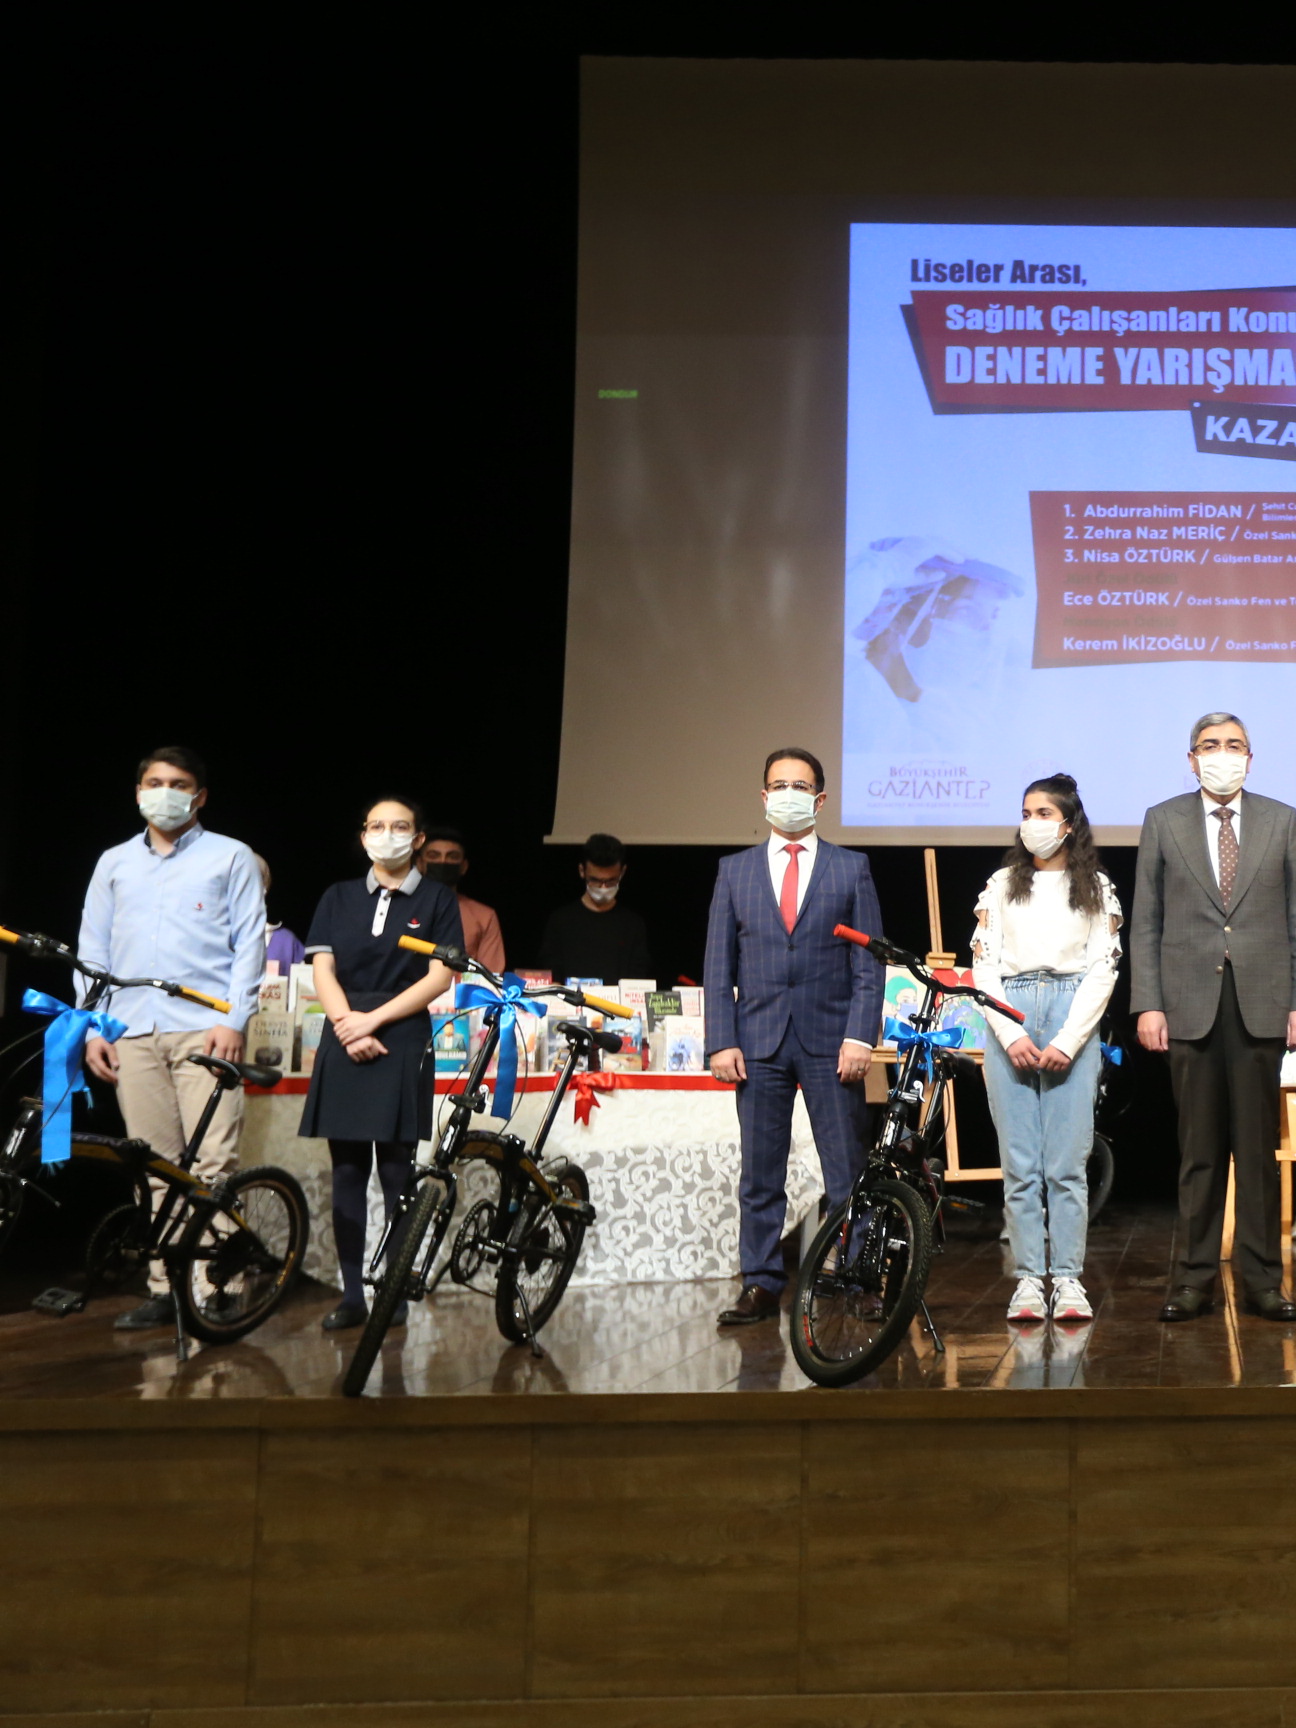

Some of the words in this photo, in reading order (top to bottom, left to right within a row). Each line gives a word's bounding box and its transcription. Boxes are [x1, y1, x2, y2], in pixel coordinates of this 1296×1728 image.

[910, 258, 1004, 284] Liseler
[1010, 259, 1087, 287] Arası,
[945, 303, 1043, 333] Sağlık
[1050, 304, 1222, 337] Çalışanları
[945, 346, 1105, 386] DENEME
[1063, 504, 1076, 518] 1.
[1084, 504, 1184, 518] Abdurrahim
[1188, 502, 1242, 518] FİDAN
[1064, 526, 1079, 540] 2.
[1083, 526, 1132, 540] Zehra
[1136, 526, 1168, 540] Naz
[1172, 524, 1226, 542] MERİÇ
[1243, 530, 1269, 540] Özel
[1064, 549, 1079, 563] 3.
[1083, 549, 1120, 563] Nisa
[1124, 547, 1197, 563] ÖZTÜRK
[1213, 553, 1251, 564] Gülşen
[1253, 554, 1283, 563] Batar
[1063, 591, 1094, 606] Ece
[1098, 589, 1170, 606] ÖZTÜRK
[1215, 596, 1248, 606] Sanko
[1251, 596, 1272, 606] Fen
[1274, 598, 1287, 606] ve
[1063, 637, 1118, 651] Kerem
[1123, 634, 1206, 651] İKİZOĞLU
[1253, 640, 1288, 650] Sanko
